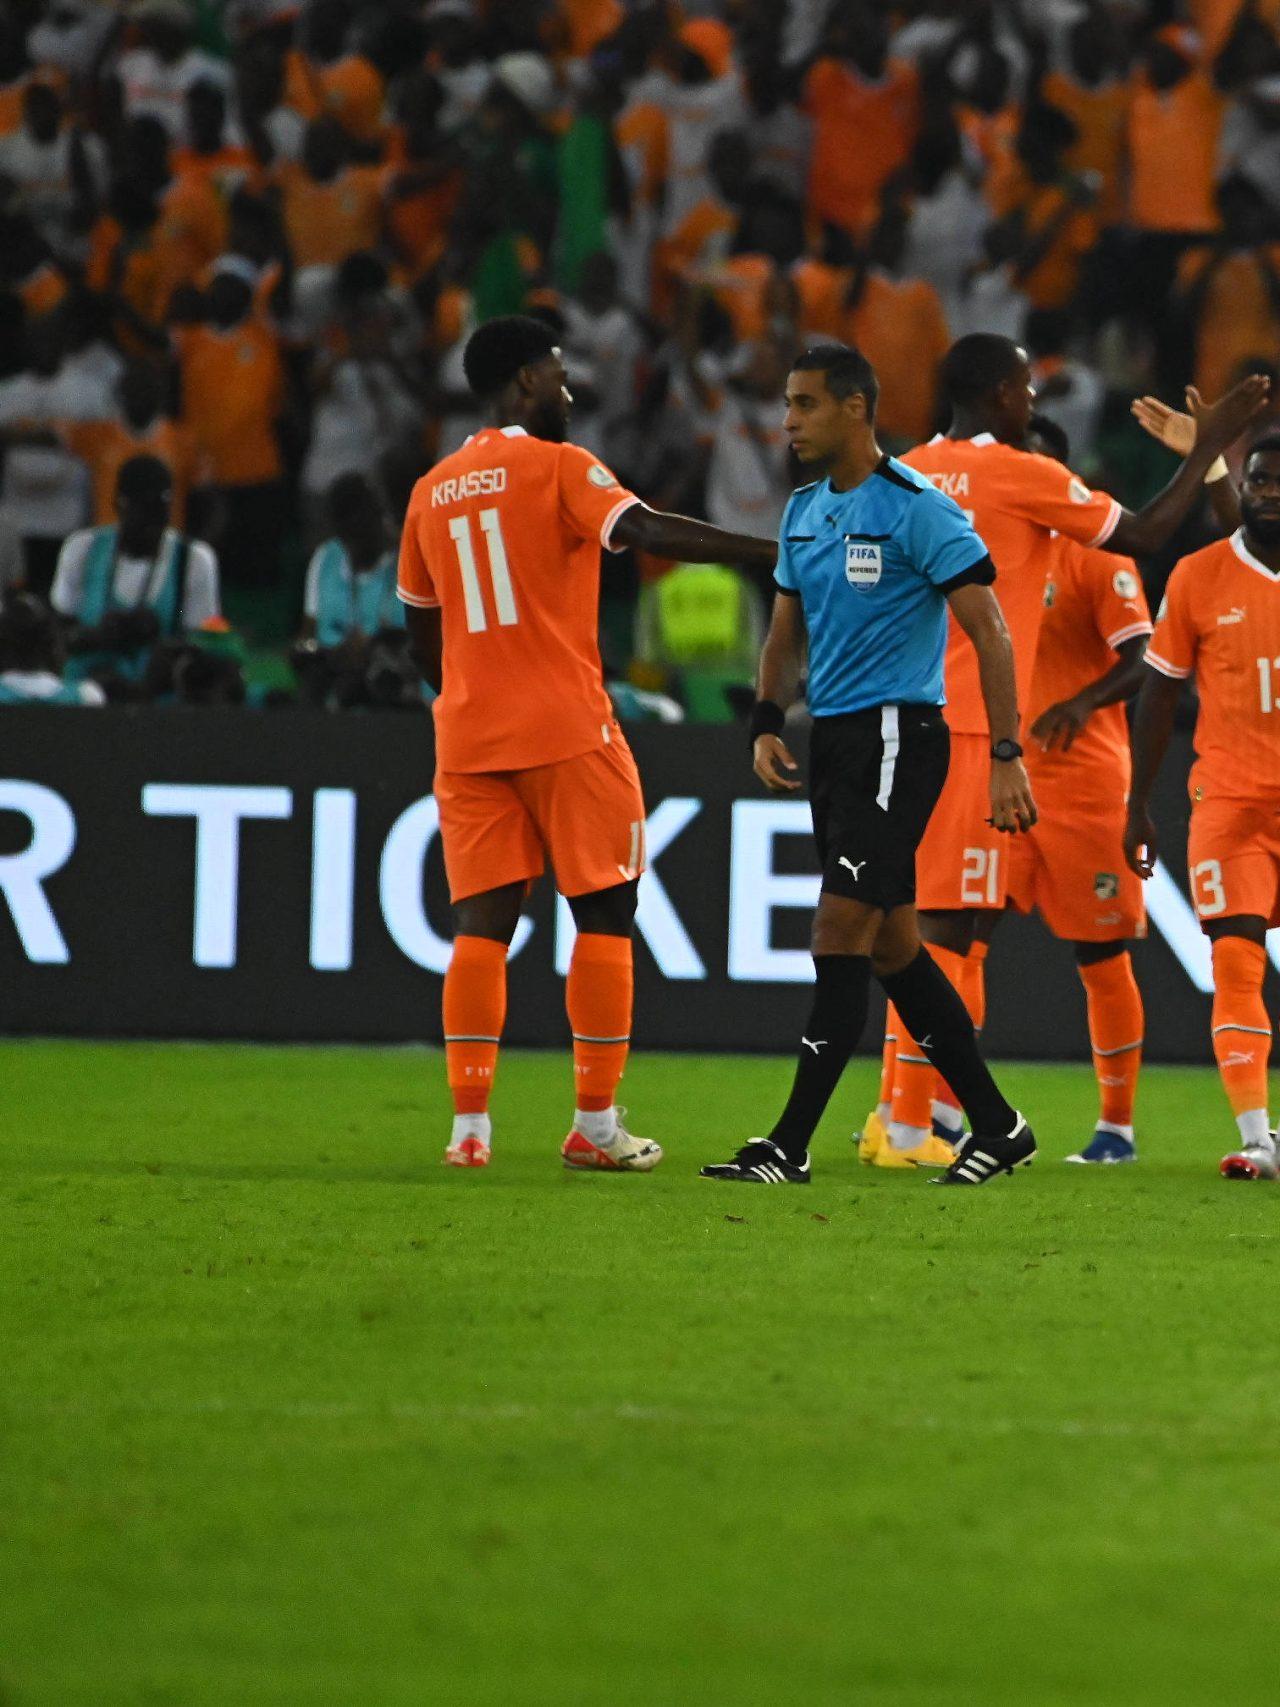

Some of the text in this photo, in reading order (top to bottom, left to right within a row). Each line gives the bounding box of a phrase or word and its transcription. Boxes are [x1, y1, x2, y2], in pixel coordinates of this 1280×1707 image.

[431, 467, 507, 508] KRASSO
[448, 507, 518, 634] 11
[849, 548, 877, 560] FIFA
[961, 848, 998, 903] 21
